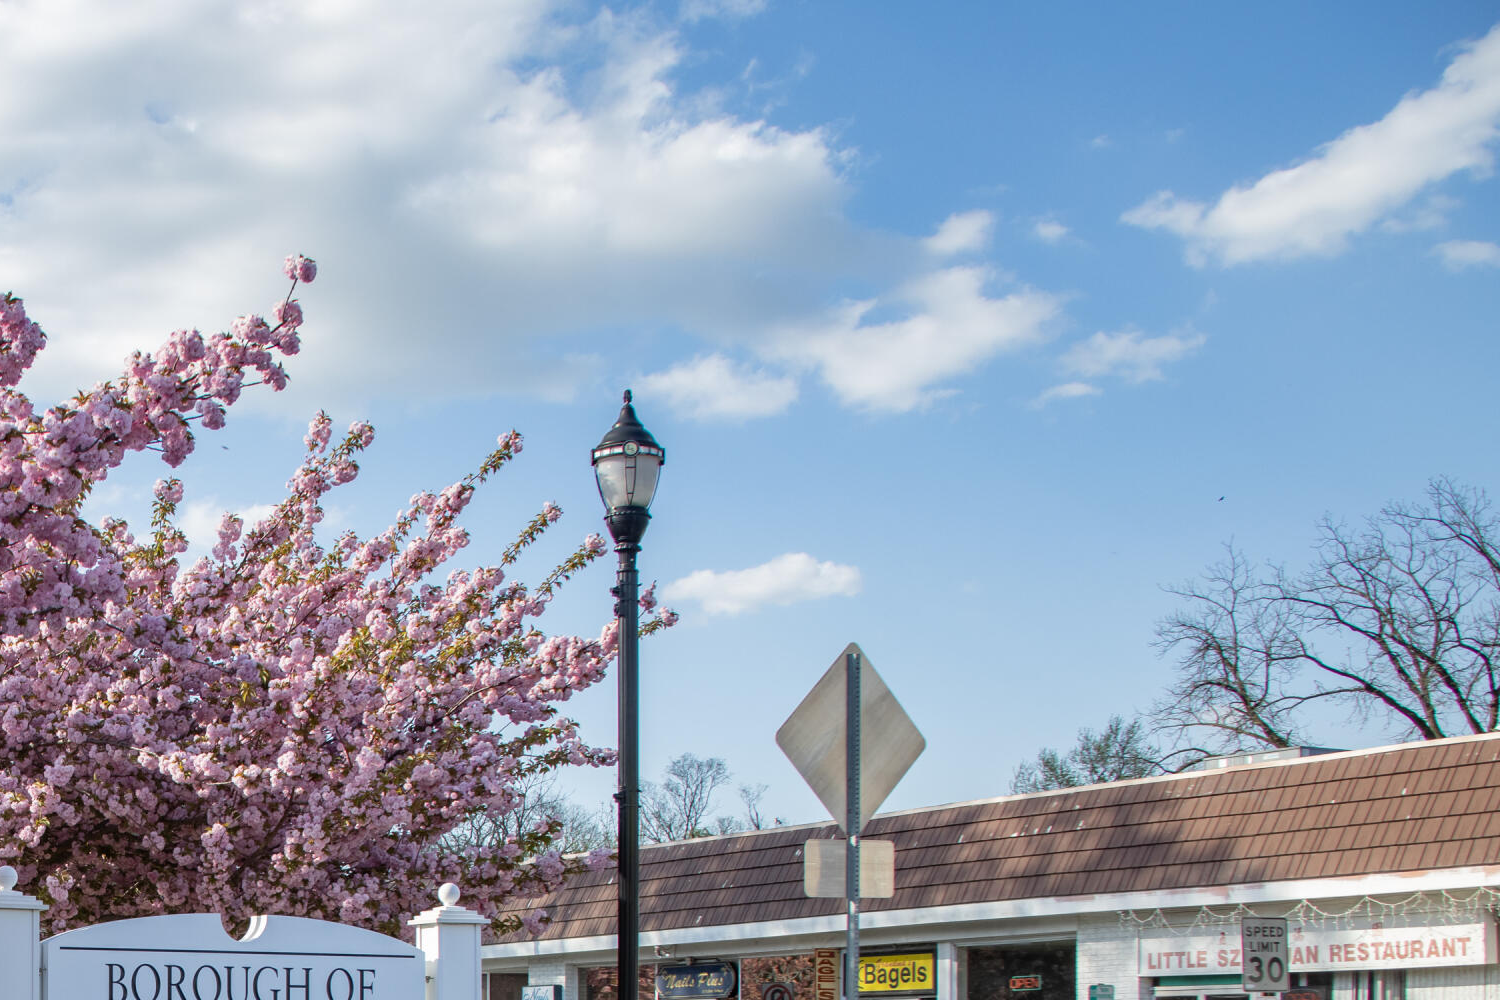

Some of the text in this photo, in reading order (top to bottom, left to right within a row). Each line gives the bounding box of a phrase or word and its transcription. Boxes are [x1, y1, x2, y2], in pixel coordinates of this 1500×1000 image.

[1245, 926, 1284, 938] SPEED
[1147, 951, 1208, 970] LITTLE
[1329, 937, 1471, 963] RESTAURANT
[1250, 942, 1280, 952] LIMIT
[864, 961, 928, 989] Bagels
[1249, 956, 1284, 983] 30
[665, 972, 724, 989] Nails Plus
[1009, 977, 1040, 989] OPEN
